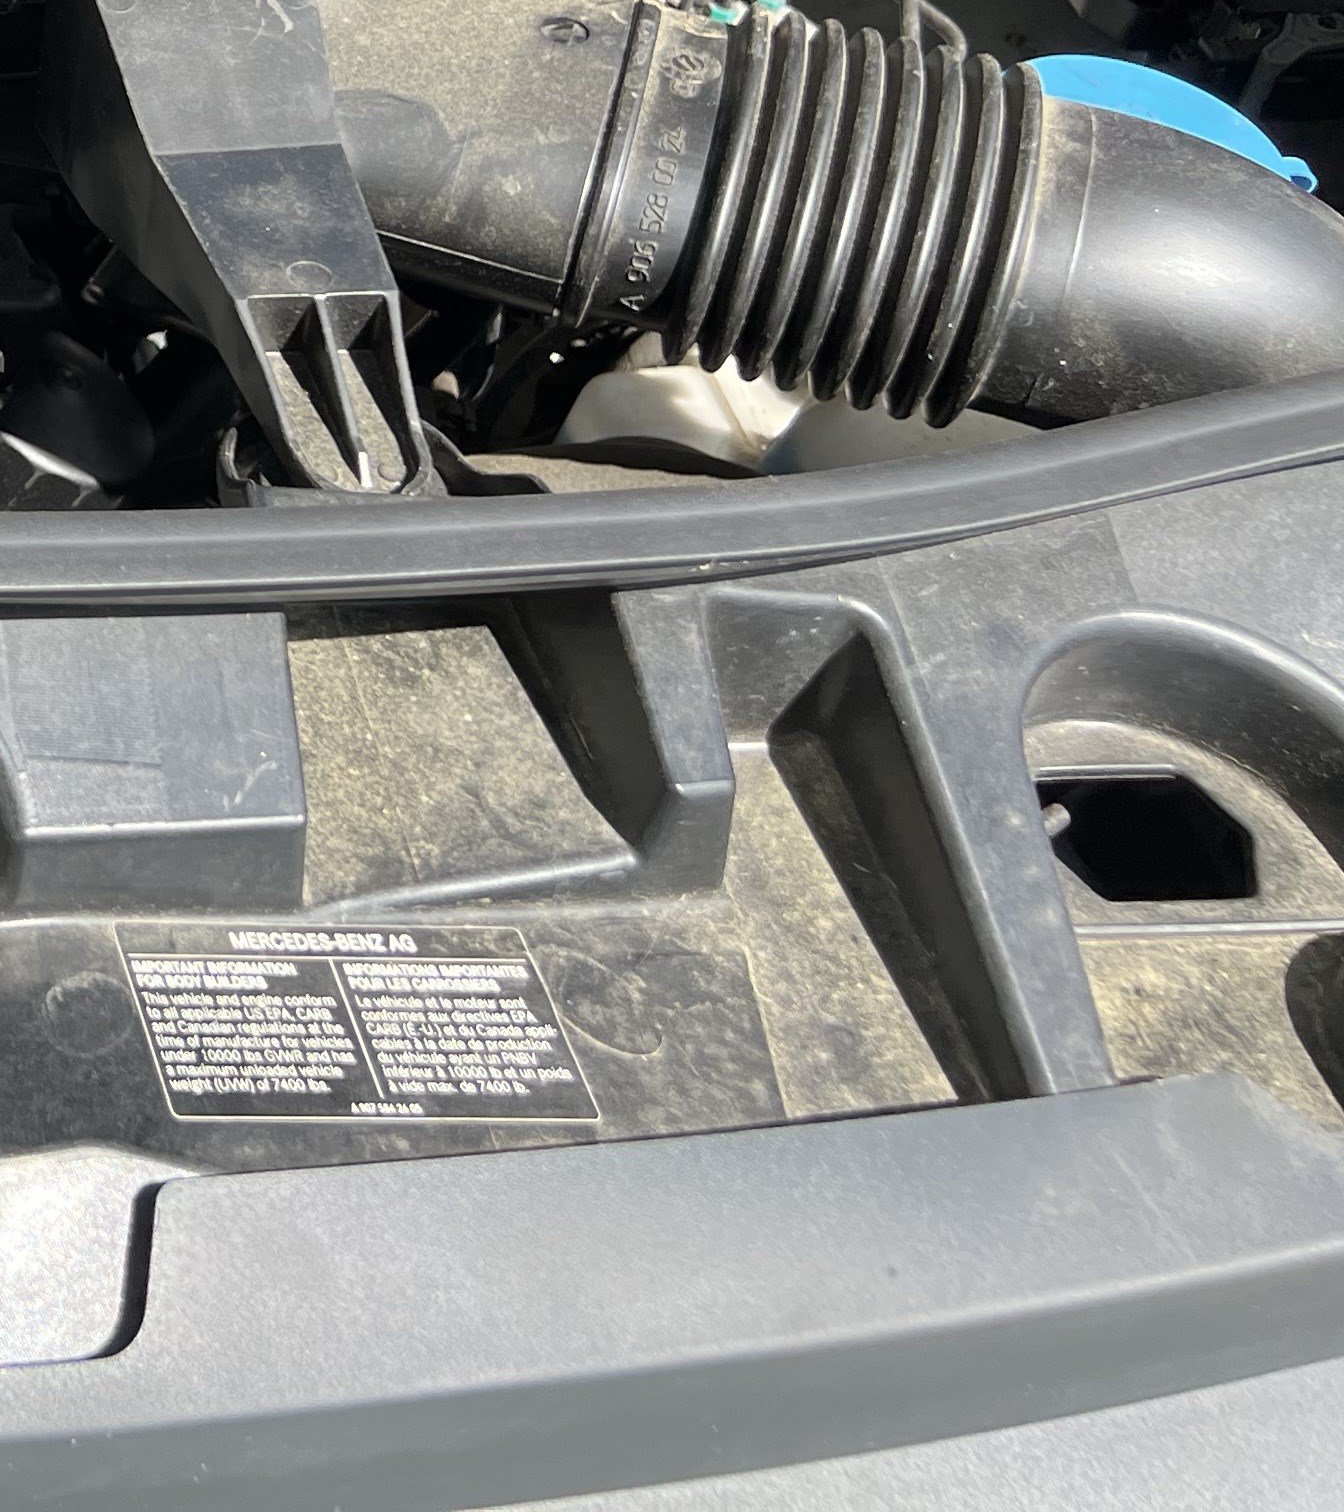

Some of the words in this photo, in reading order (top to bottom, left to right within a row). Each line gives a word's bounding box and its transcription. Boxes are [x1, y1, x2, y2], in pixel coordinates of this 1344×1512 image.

[228, 931, 387, 952] MERCEDES-BENZ
[386, 933, 417, 952] AG
[131, 960, 205, 974] IMPORTANT
[207, 961, 297, 975] INFORMATION
[343, 963, 439, 977] INFORMATIONS
[440, 964, 528, 978] IMPORTANTES
[136, 974, 164, 987] FOR
[166, 974, 202, 988] BODY
[203, 975, 268, 989] BUILDERS
[348, 976, 385, 990] POUR
[386, 977, 411, 990] LES
[411, 977, 500, 991] CARROSSIERS
[143, 992, 168, 1004] This
[170, 992, 213, 1005] vehicle
[215, 992, 239, 1005] and
[241, 993, 283, 1007] engine
[284, 993, 336, 1006] conform
[355, 994, 372, 1007] Le
[373, 995, 423, 1007] véhicule
[424, 995, 439, 1008] et
[439, 995, 452, 1008] le
[453, 995, 497, 1008] moteur
[498, 996, 526, 1009] sont
[146, 1006, 161, 1018] to
[163, 1006, 178, 1018] all
[180, 1006, 243, 1021] applicable
[244, 1007, 263, 1019] US
[296, 1007, 332, 1020] CARB
[361, 1009, 425, 1021] conformes
[426, 1010, 449, 1021] aux
[450, 1010, 510, 1022] directives
[511, 1011, 537, 1022] EPA
[151, 1021, 176, 1033] and
[178, 1021, 235, 1033] Canadian
[237, 1022, 306, 1035] regulations
[307, 1023, 320, 1034] at
[323, 1023, 345, 1034] the
[366, 1022, 401, 1035] CARB
[442, 1023, 456, 1036] et
[458, 1023, 475, 1036] du
[476, 1023, 523, 1036] Canada
[524, 1025, 559, 1038] appli-
[156, 1035, 184, 1047] time
[187, 1035, 200, 1047] of
[202, 1035, 280, 1047] manufacture
[282, 1036, 300, 1048] for
[302, 1036, 353, 1048] vehicles
[371, 1037, 412, 1049] cables
[424, 1037, 437, 1049] la
[438, 1037, 466, 1049] date
[467, 1038, 484, 1049] de
[485, 1038, 552, 1051] production
[161, 1049, 196, 1061] under
[202, 1049, 241, 1061] 10000
[243, 1050, 262, 1062] lbs
[264, 1050, 304, 1062] GVWR
[306, 1050, 330, 1062] and
[332, 1050, 355, 1062] has
[377, 1051, 394, 1063] du
[395, 1051, 446, 1063] véhicule
[448, 1052, 482, 1065] ayant
[484, 1052, 500, 1064] un
[502, 1052, 538, 1064] PNBV
[166, 1066, 176, 1075] a
[176, 1063, 238, 1075] maximum
[239, 1064, 297, 1076] unloaded
[299, 1064, 343, 1076] vehicle
[382, 1065, 434, 1077] inférieur
[448, 1065, 488, 1078] 10000
[489, 1066, 501, 1078] lb
[503, 1066, 518, 1078] et
[519, 1066, 536, 1078] un
[537, 1066, 573, 1080] poids
[170, 1078, 212, 1093] weight
[214, 1078, 255, 1092] (UVW)
[256, 1078, 270, 1091] of
[272, 1079, 306, 1091] 7400
[399, 1079, 425, 1092] vide
[459, 1079, 477, 1092] de
[477, 1080, 511, 1092] 7400
